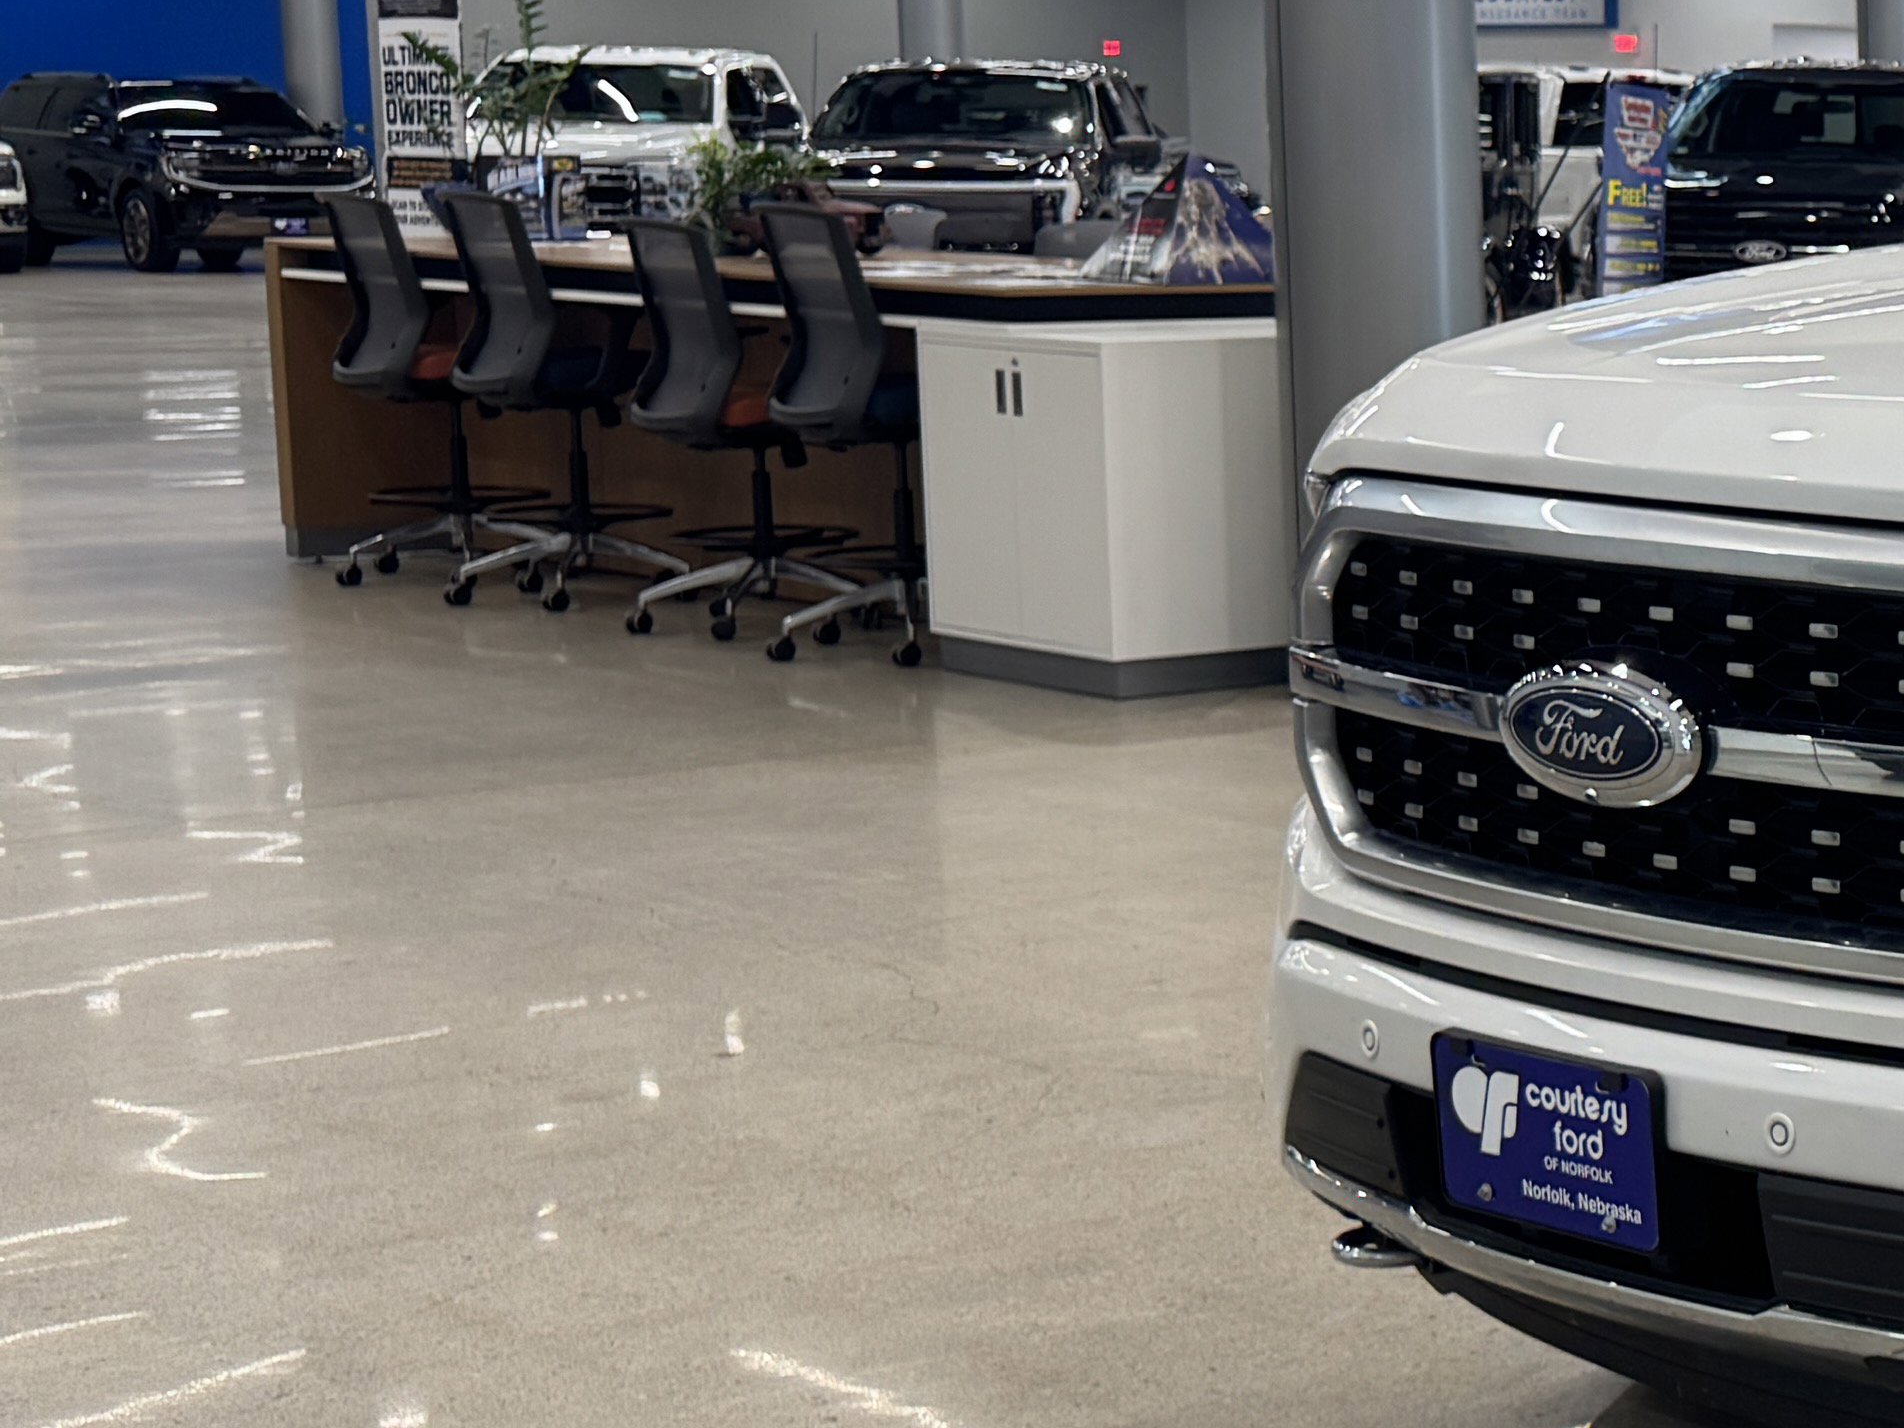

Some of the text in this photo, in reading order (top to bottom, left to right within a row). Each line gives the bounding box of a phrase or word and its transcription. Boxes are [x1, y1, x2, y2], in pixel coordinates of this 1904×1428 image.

[384, 71, 451, 96] BRONCO
[1535, 699, 1625, 766] Ford
[1525, 1082, 1628, 1136] courtesy
[1553, 1120, 1604, 1160] ford
[1544, 1155, 1613, 1185] OF NORFOLK
[1522, 1178, 1642, 1225] Norfolk, Nebraska
